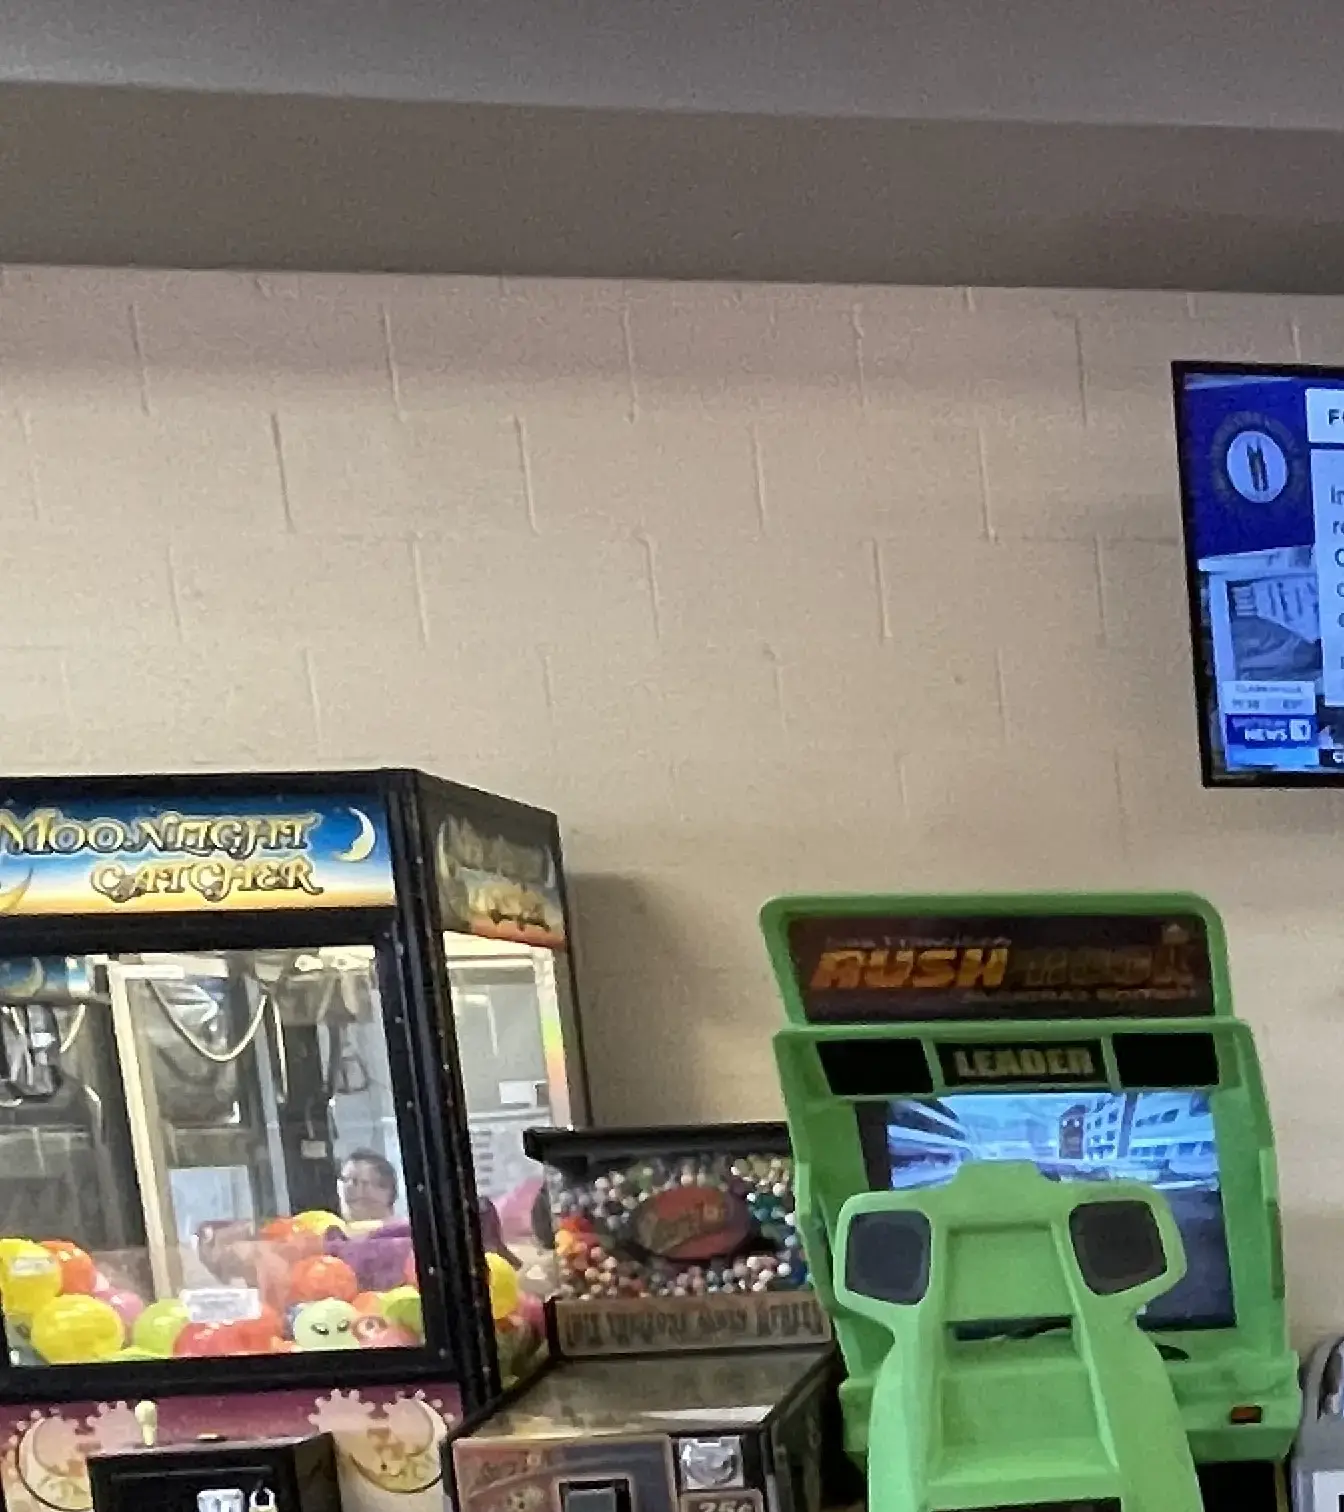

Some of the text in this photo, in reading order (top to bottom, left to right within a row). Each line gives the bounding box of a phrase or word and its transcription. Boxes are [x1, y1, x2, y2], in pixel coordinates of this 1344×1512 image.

[90, 857, 325, 903] CATCHER
[810, 945, 1009, 989] RUSH
[953, 1046, 1095, 1077] LEADER
